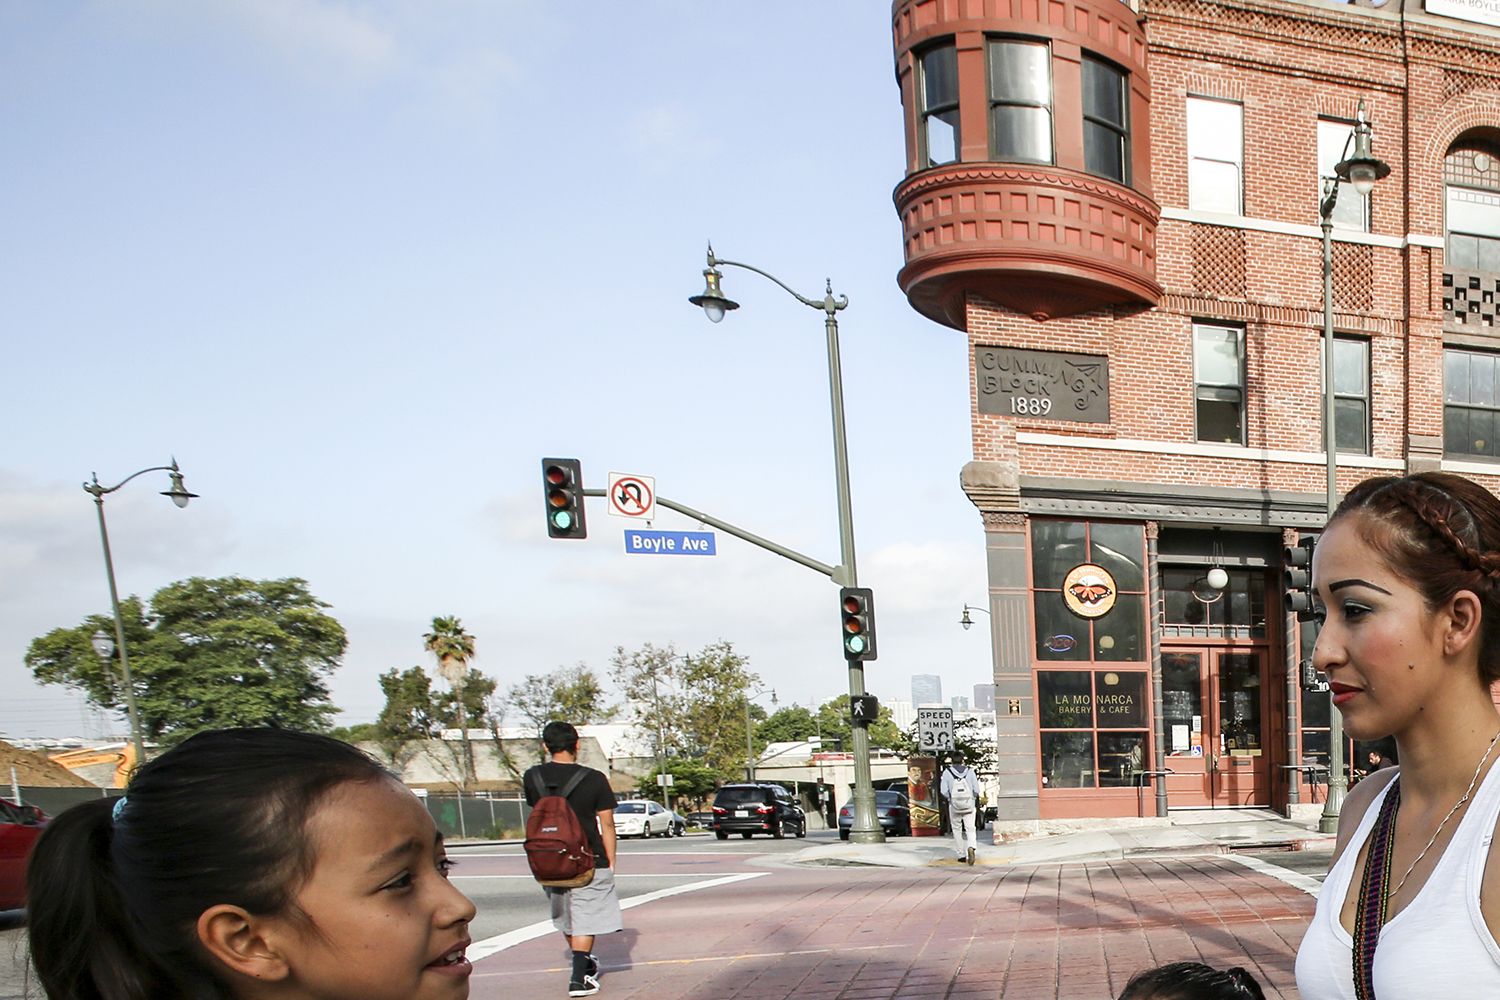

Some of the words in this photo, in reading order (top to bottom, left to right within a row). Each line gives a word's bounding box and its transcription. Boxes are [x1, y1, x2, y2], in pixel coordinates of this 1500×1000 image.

[982, 375, 1051, 396] BLOCK
[1010, 396, 1052, 416] 1889
[632, 534, 676, 553] Boyle
[682, 537, 709, 552] Ave
[1044, 635, 1078, 649] Open
[1055, 695, 1069, 705] LA
[1073, 694, 1133, 705] MONARCA
[920, 711, 951, 719] SPEED
[1058, 706, 1092, 714] BAKERY
[1099, 705, 1106, 714] &
[1108, 705, 1130, 714] CAFE
[922, 721, 949, 729] IMIT
